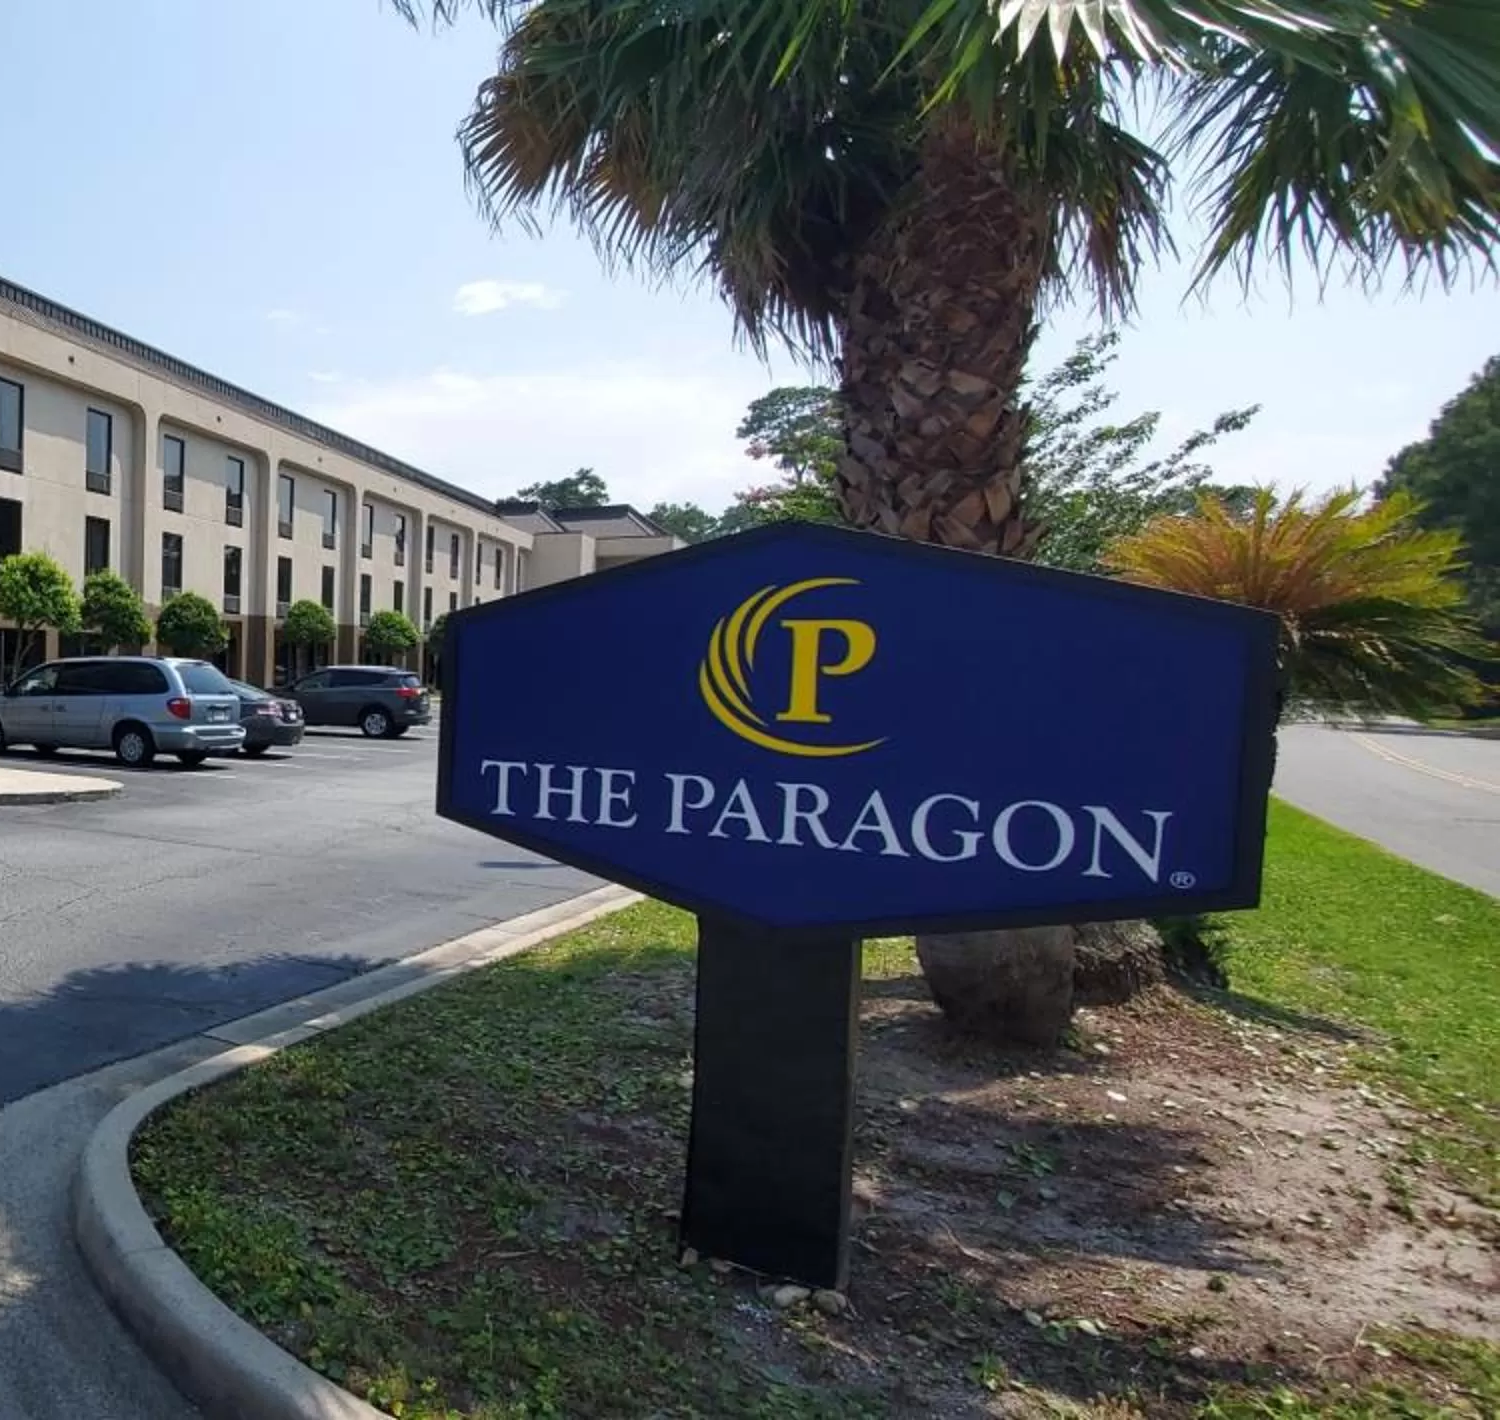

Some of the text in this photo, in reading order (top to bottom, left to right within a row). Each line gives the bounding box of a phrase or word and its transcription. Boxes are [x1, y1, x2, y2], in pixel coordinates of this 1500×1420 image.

[775, 619, 876, 722] P
[480, 759, 639, 828] THE
[664, 773, 1174, 883] PARAGON
